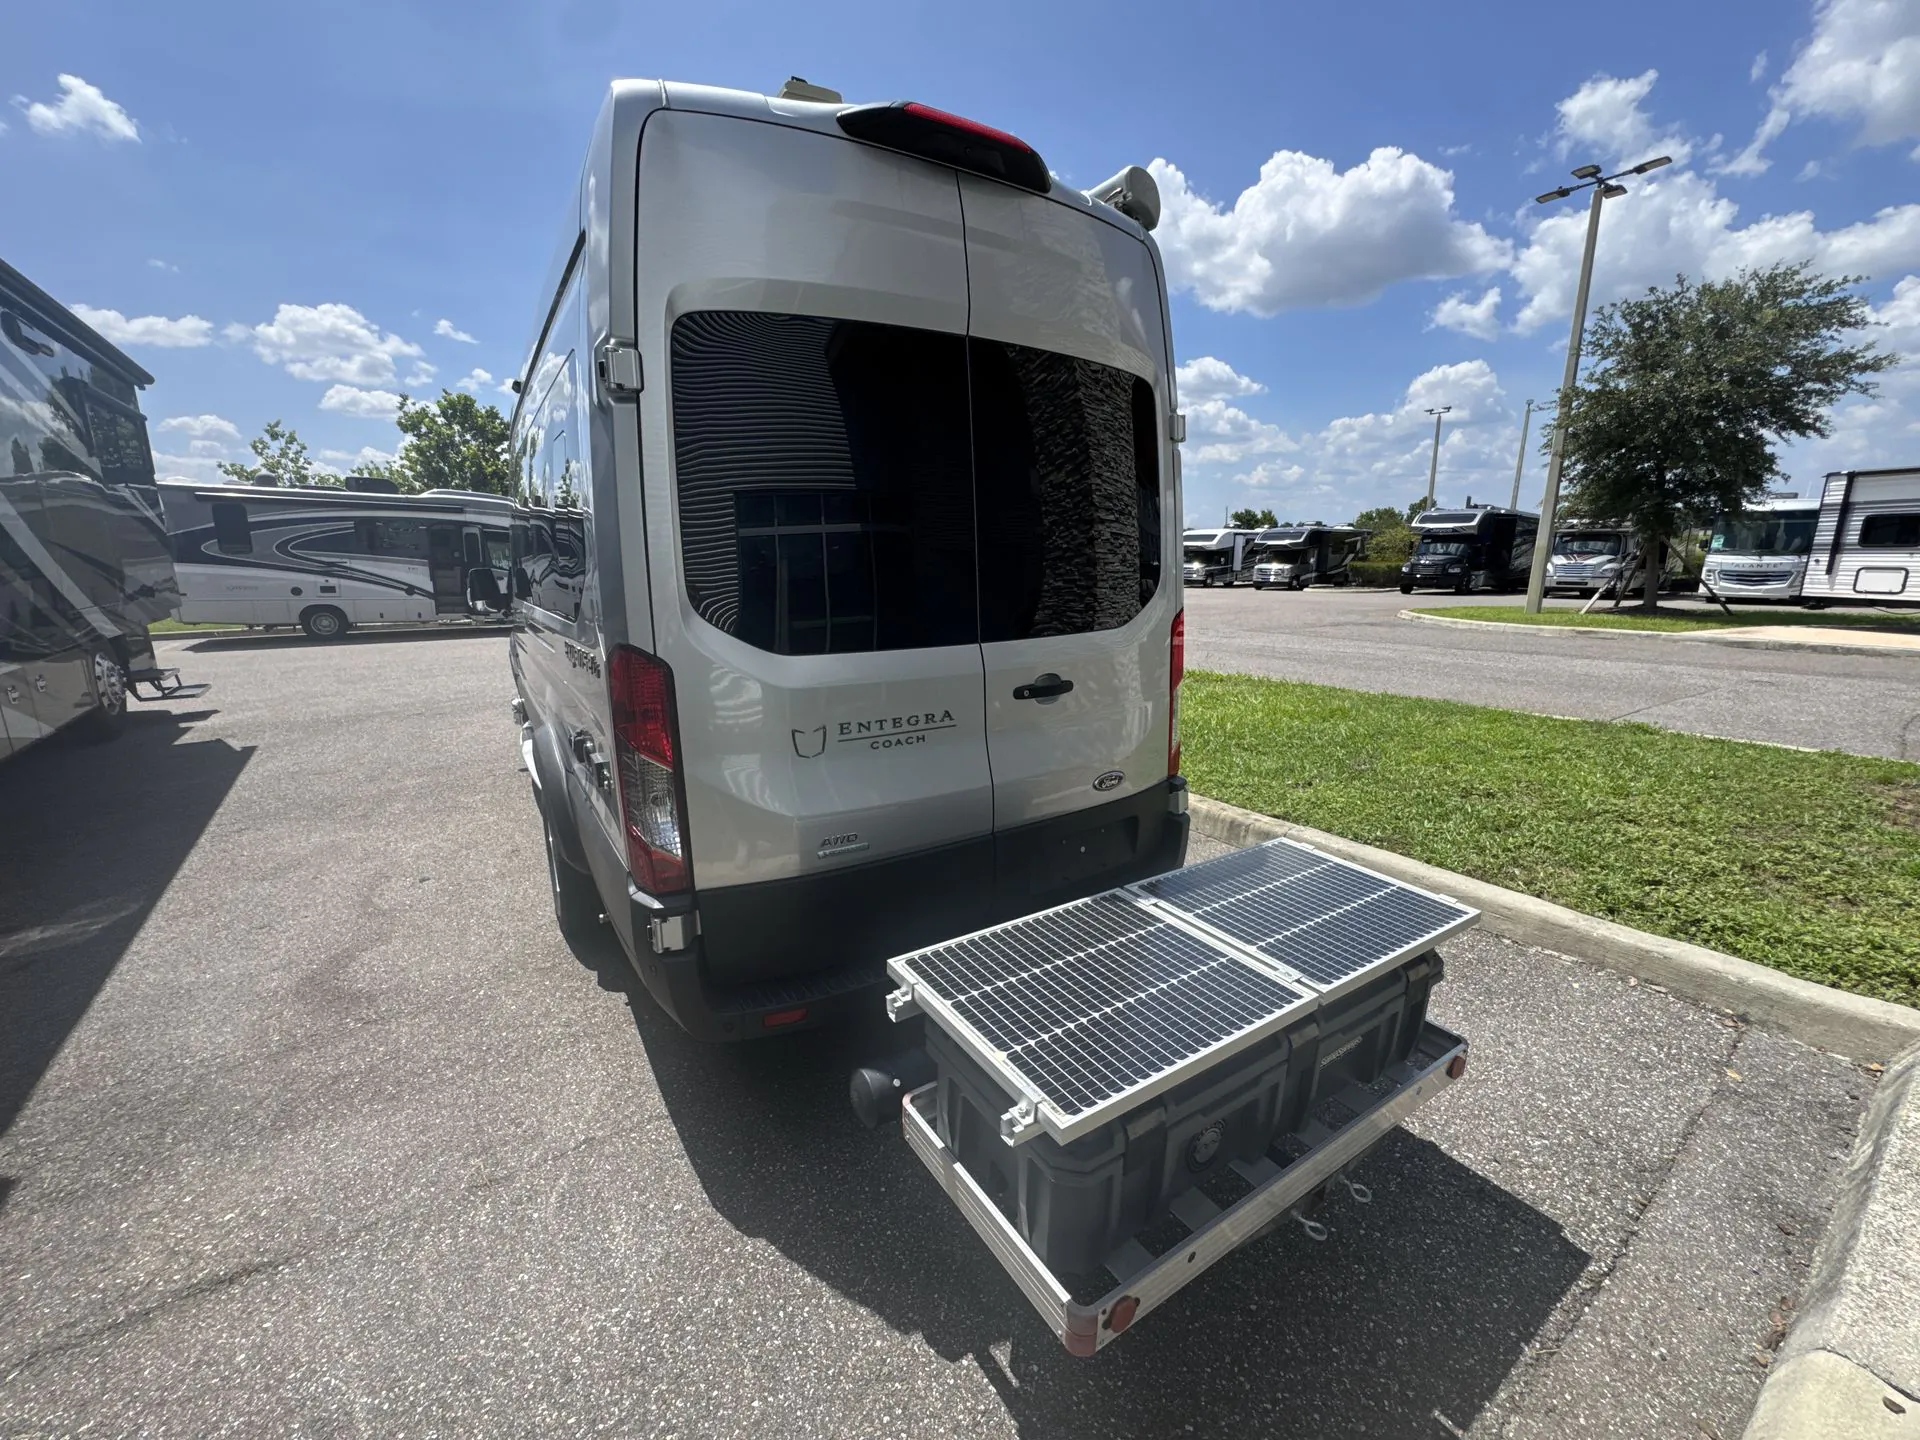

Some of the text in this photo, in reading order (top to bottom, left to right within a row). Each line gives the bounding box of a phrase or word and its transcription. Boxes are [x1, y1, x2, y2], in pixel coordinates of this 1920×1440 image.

[838, 709, 955, 736] ENTEGRA
[870, 734, 926, 750] COACH
[1098, 773, 1121, 789] Ford
[820, 832, 858, 848] AWD
